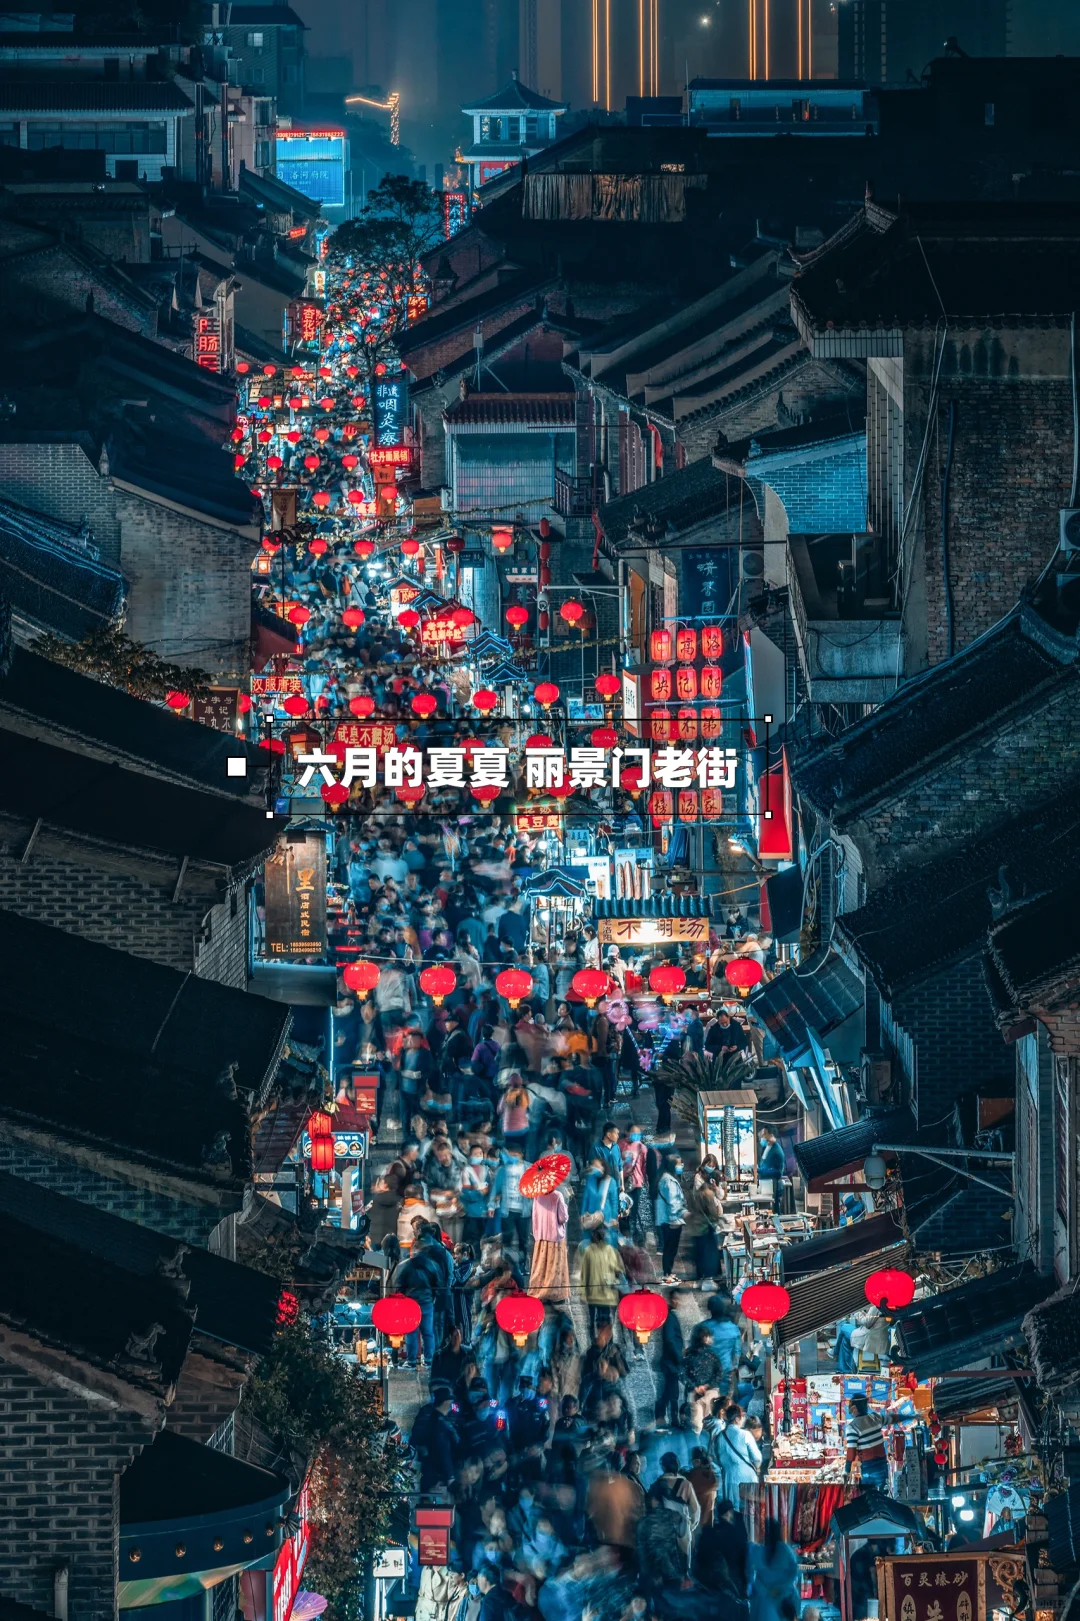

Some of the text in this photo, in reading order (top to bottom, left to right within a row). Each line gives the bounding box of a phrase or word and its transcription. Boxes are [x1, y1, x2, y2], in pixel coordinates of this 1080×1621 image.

[302, 307, 316, 341] 杏花村
[253, 677, 301, 693] 汉服唐装
[518, 815, 560, 829] 臭豆腐
[270, 943, 289, 953] TEL:
